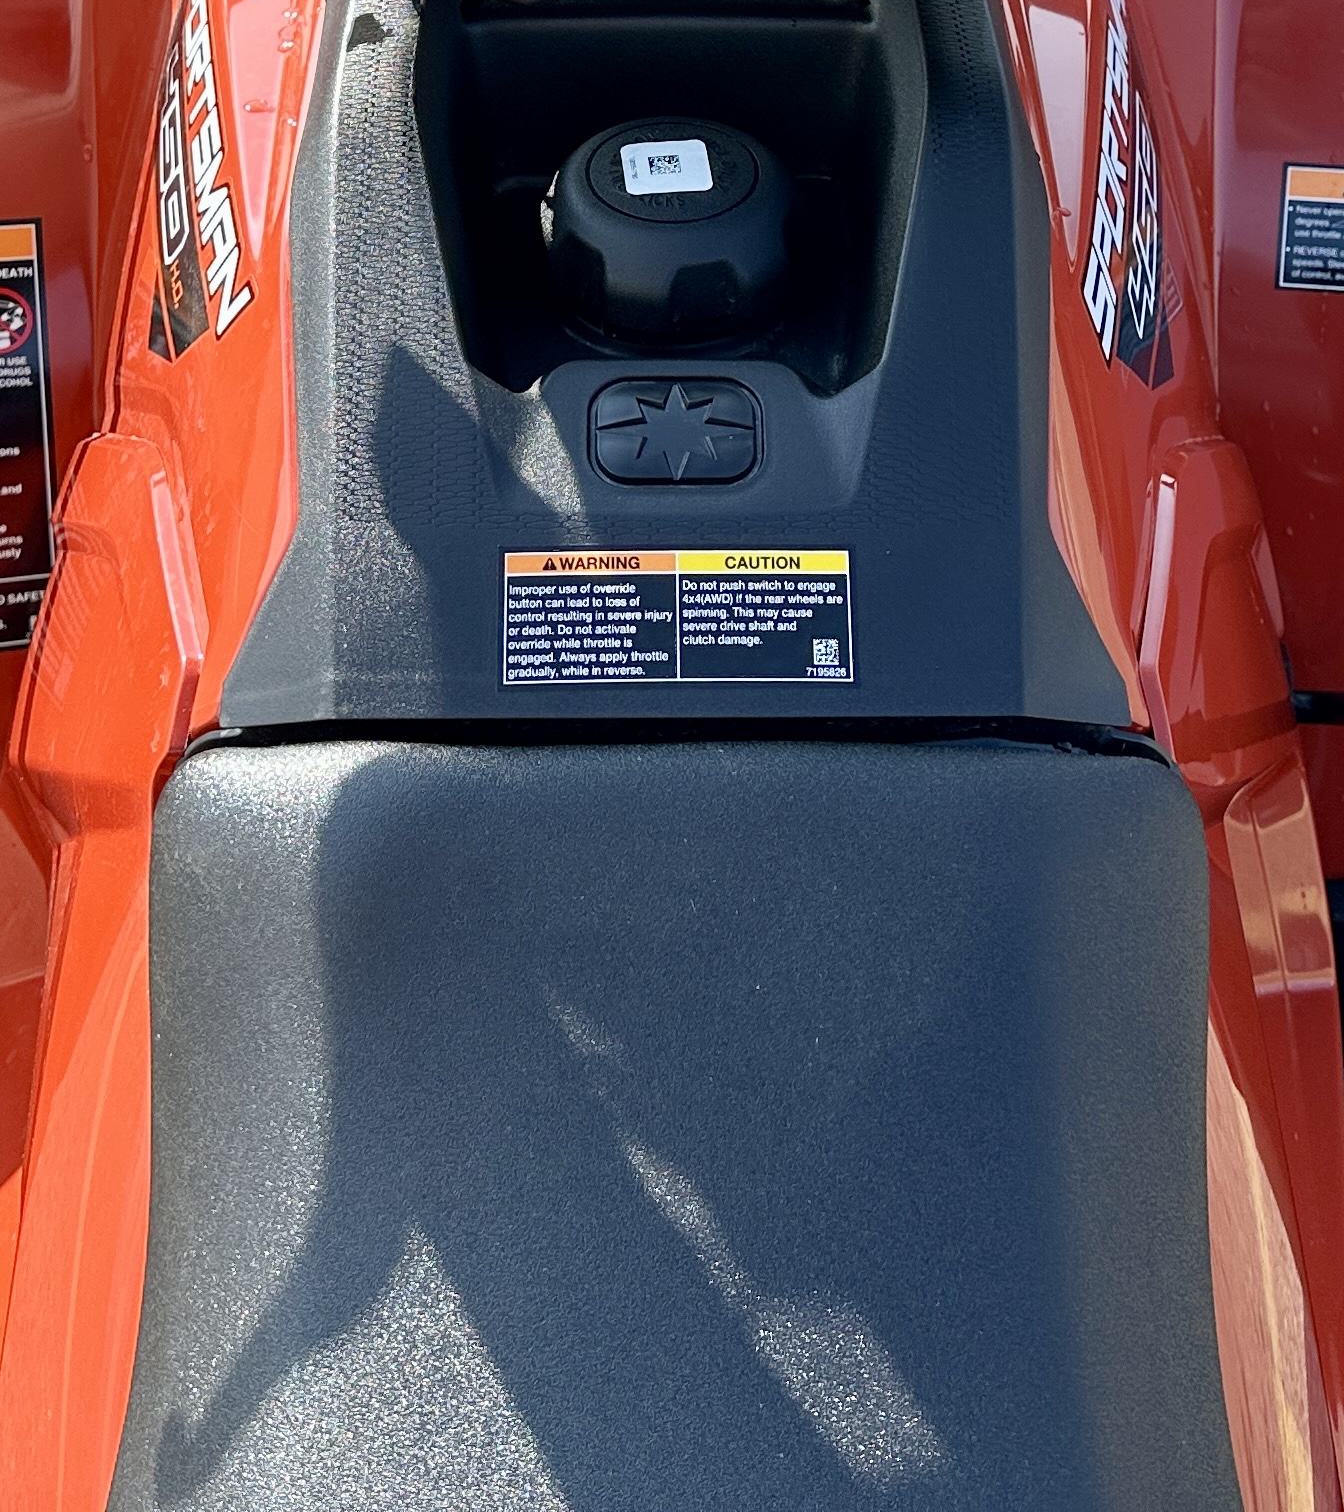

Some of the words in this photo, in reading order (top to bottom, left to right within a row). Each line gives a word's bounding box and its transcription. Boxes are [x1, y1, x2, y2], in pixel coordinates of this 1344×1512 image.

[559, 556, 640, 571] WARNING
[724, 556, 800, 570] CAUTION
[509, 585, 557, 597] Improper
[558, 585, 578, 595] use
[579, 582, 591, 594] of
[593, 583, 636, 594] override
[682, 579, 698, 591] Do
[699, 580, 717, 591] not
[719, 579, 746, 593] push
[747, 579, 782, 591] switch
[783, 580, 796, 591] to
[797, 582, 836, 593] engage
[508, 598, 543, 609] button
[544, 599, 565, 608] can
[567, 596, 590, 608] lead
[592, 596, 603, 608] to
[605, 596, 627, 608] loss
[628, 596, 641, 607] of
[682, 593, 734, 606] 4x4(AWD)
[735, 593, 743, 604] if
[744, 593, 762, 604] the
[764, 595, 786, 604] rear
[787, 593, 824, 605] wheels
[826, 595, 844, 605] are
[508, 611, 545, 623] control
[547, 610, 593, 623] resulting
[595, 610, 605, 621] in
[607, 611, 642, 621] severe
[644, 609, 673, 623] injury
[682, 607, 729, 620] spinning.
[732, 606, 755, 618] This
[756, 608, 780, 620] may
[781, 608, 813, 618] cause
[508, 627, 520, 637] or
[521, 624, 555, 636] death.
[557, 624, 573, 635] Do
[574, 624, 593, 635] not
[594, 623, 637, 635] activate
[682, 622, 718, 632] severe
[719, 620, 747, 632] drive
[748, 620, 775, 631] shaft
[776, 620, 797, 631] and
[507, 638, 551, 650] override
[553, 637, 581, 649] while
[583, 637, 621, 648] throttle
[623, 636, 633, 648] is
[682, 634, 716, 645] clutch
[717, 634, 763, 647] damage.
[507, 652, 557, 666] engaged.
[559, 651, 597, 665] Always
[599, 651, 629, 664] apply
[630, 650, 669, 662] throttle
[507, 666, 559, 680] gradually,
[561, 665, 590, 676] while
[591, 664, 602, 676] in
[603, 666, 646, 676] reverse.
